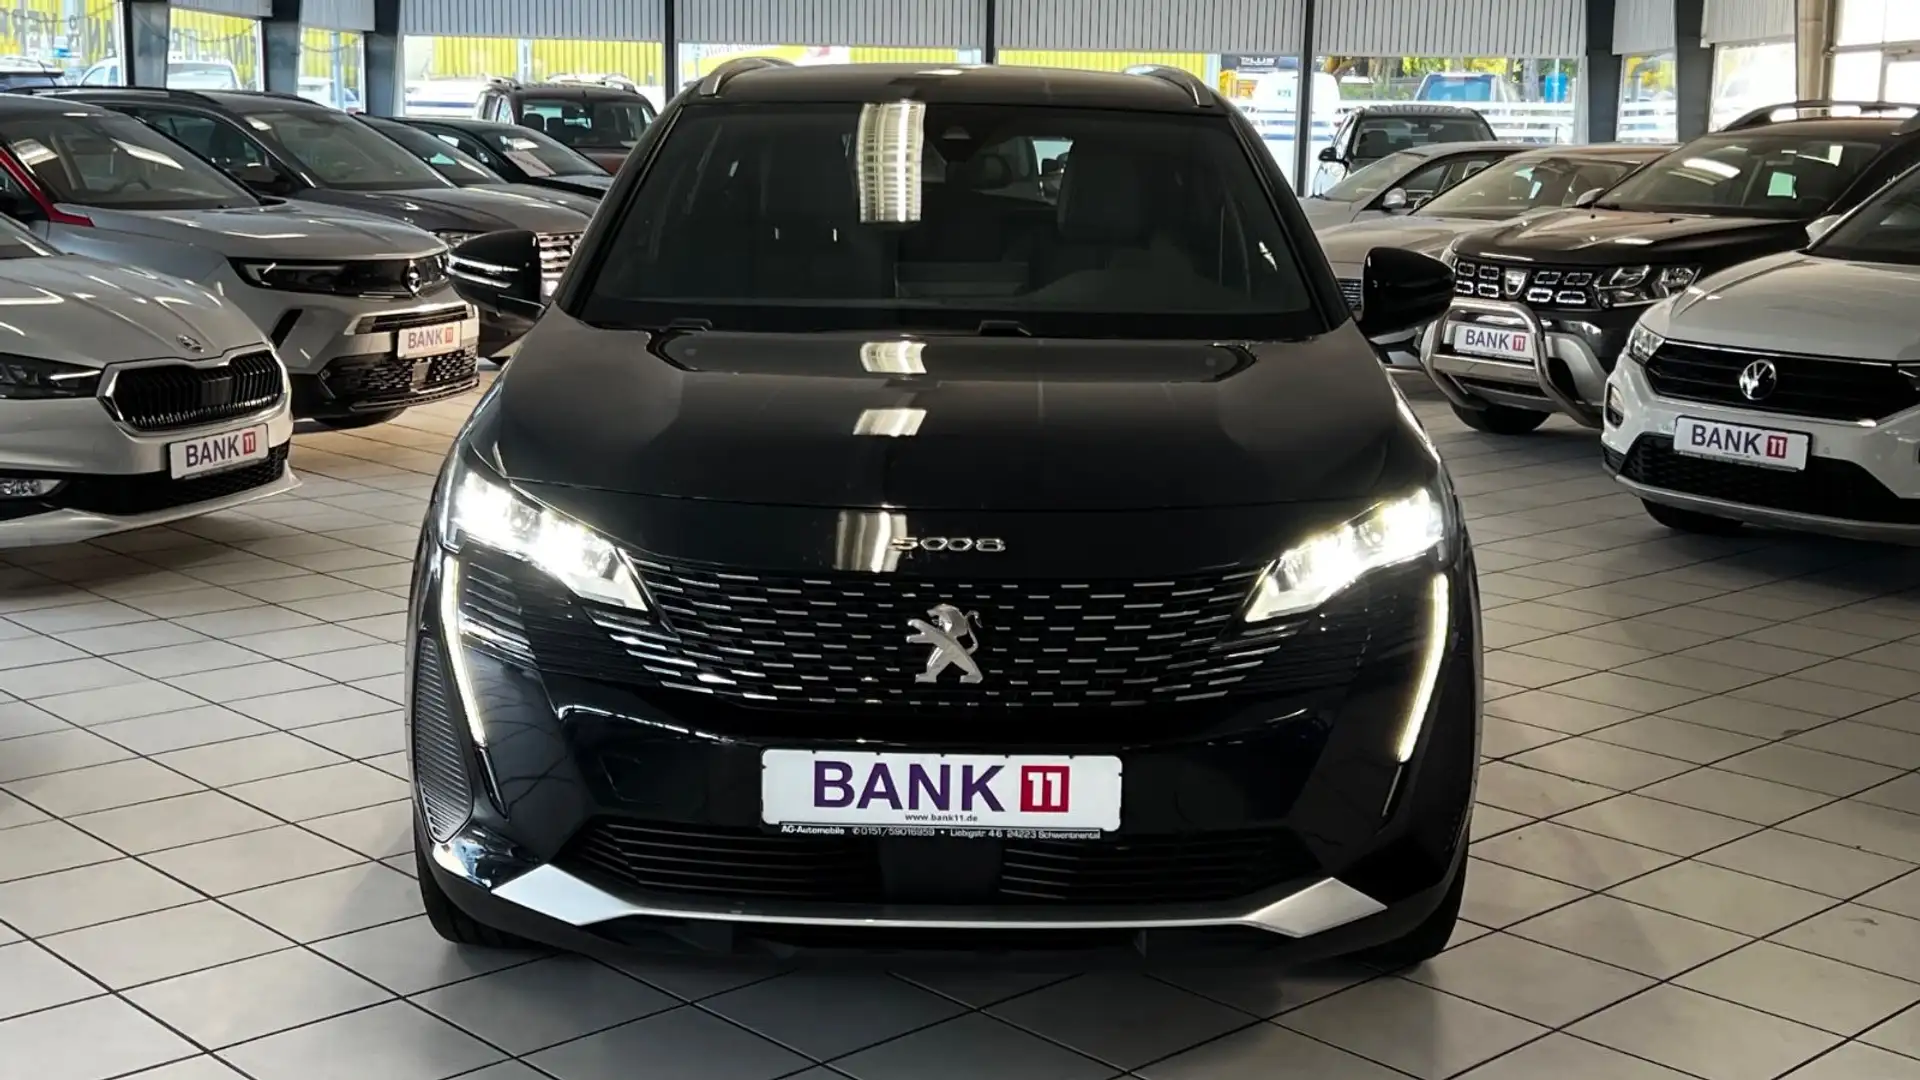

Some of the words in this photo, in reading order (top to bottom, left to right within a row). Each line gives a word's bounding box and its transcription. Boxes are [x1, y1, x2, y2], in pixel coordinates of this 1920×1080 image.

[408, 328, 443, 349] BANK
[1465, 329, 1510, 350] BANK
[1513, 335, 1526, 351] 11
[185, 434, 240, 467] BANK
[244, 433, 255, 454] 11
[1691, 424, 1762, 455] BANK
[1768, 437, 1786, 457] 11
[890, 537, 1006, 551] 5008
[813, 760, 1005, 812] BANK
[1024, 769, 1066, 809] 11
[905, 814, 978, 822] www.bank11.de
[781, 825, 845, 835] AG-Automobile
